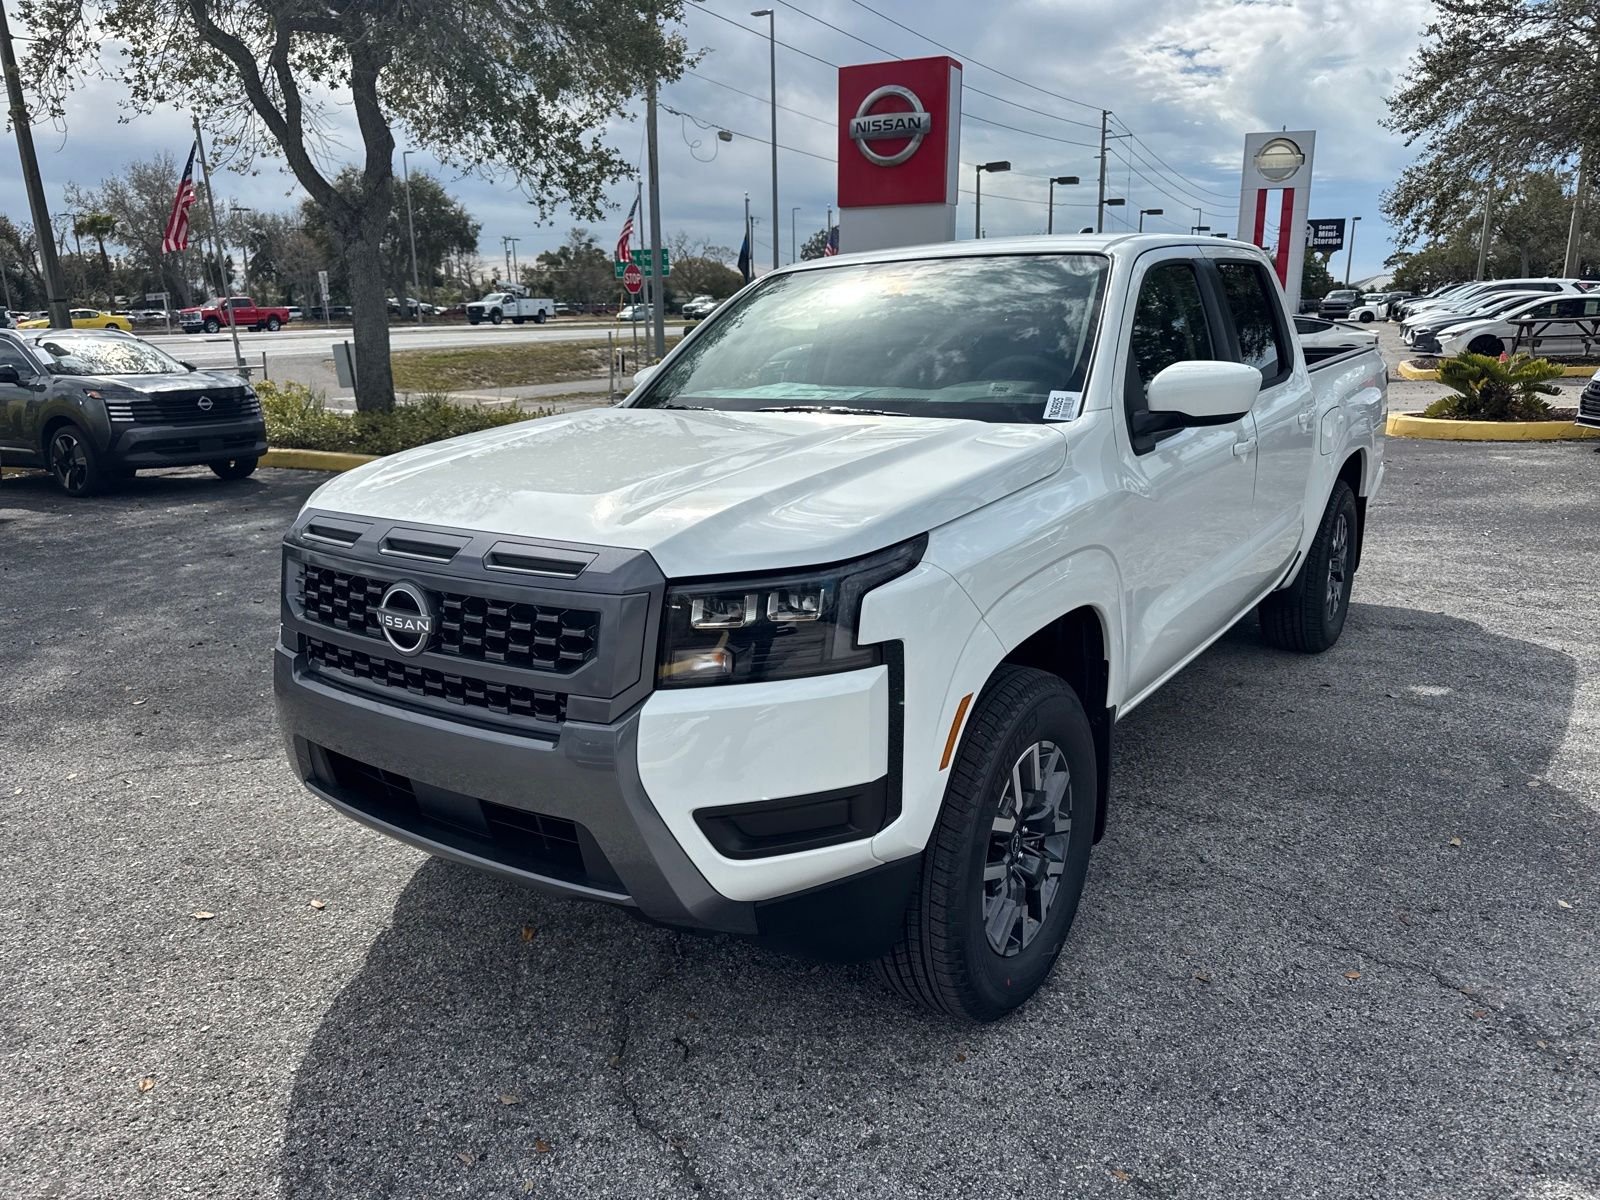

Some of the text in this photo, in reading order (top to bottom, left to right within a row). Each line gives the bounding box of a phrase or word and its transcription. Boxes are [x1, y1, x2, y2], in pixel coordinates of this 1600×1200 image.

[855, 116, 922, 134] NISSAN
[1313, 237, 1342, 245] Storage
[625, 272, 641, 285] STOP
[376, 610, 430, 632] NISSAN
